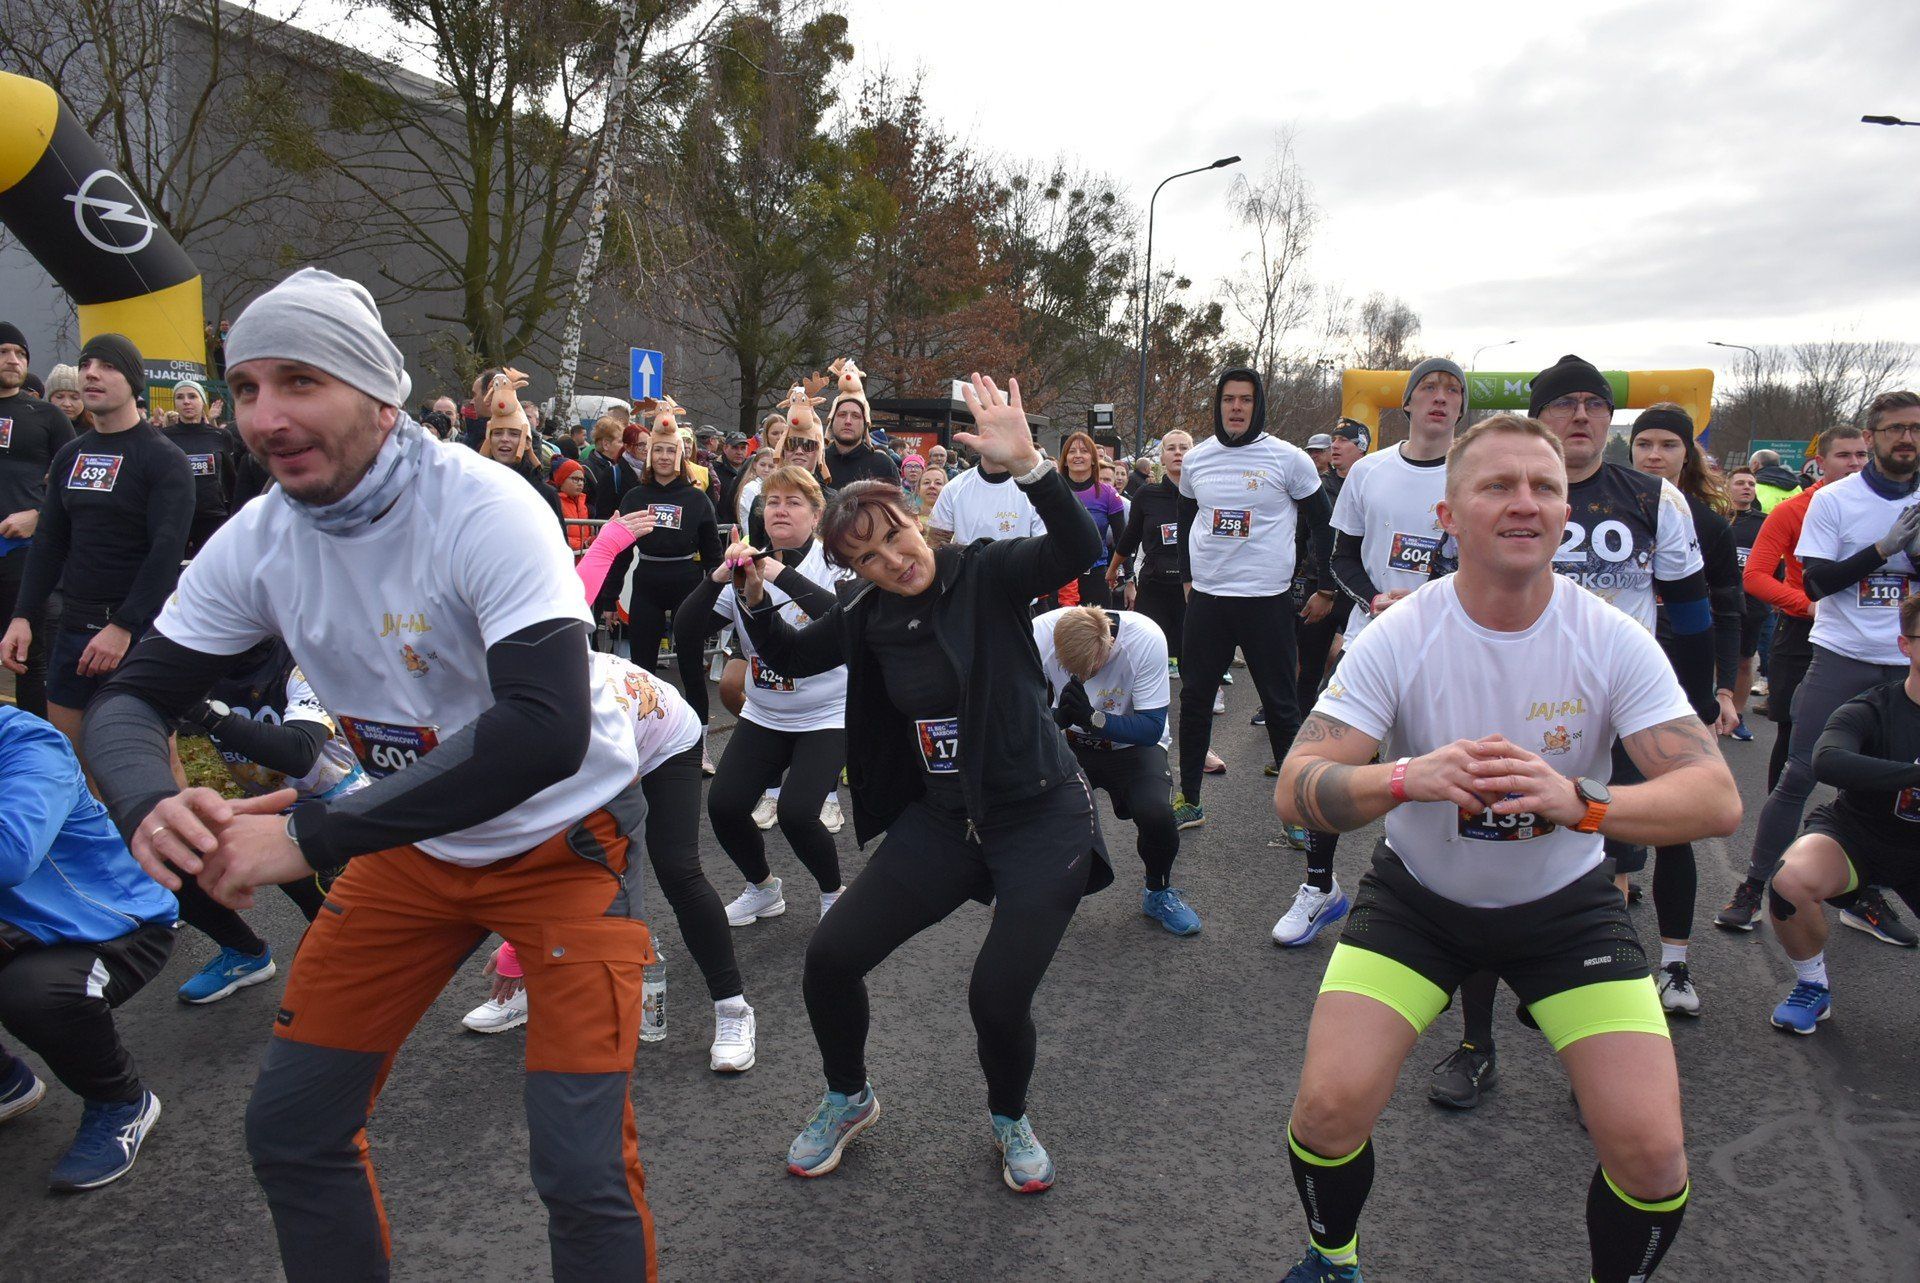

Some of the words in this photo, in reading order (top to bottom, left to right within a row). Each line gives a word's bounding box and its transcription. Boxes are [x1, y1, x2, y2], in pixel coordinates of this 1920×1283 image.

[170, 360, 196, 372] OPEL
[191, 461, 208, 470] 288
[81, 467, 107, 480] 639
[655, 511, 673, 521] 786
[1219, 518, 1241, 530] 258
[1550, 519, 1648, 563] 20.
[1401, 548, 1431, 564] 604
[1871, 586, 1900, 599] 110
[760, 669, 783, 682] 424
[935, 739, 958, 758] 17
[371, 744, 419, 770] 601
[1481, 806, 1536, 828] 135
[656, 991, 664, 1028] OSHEE
